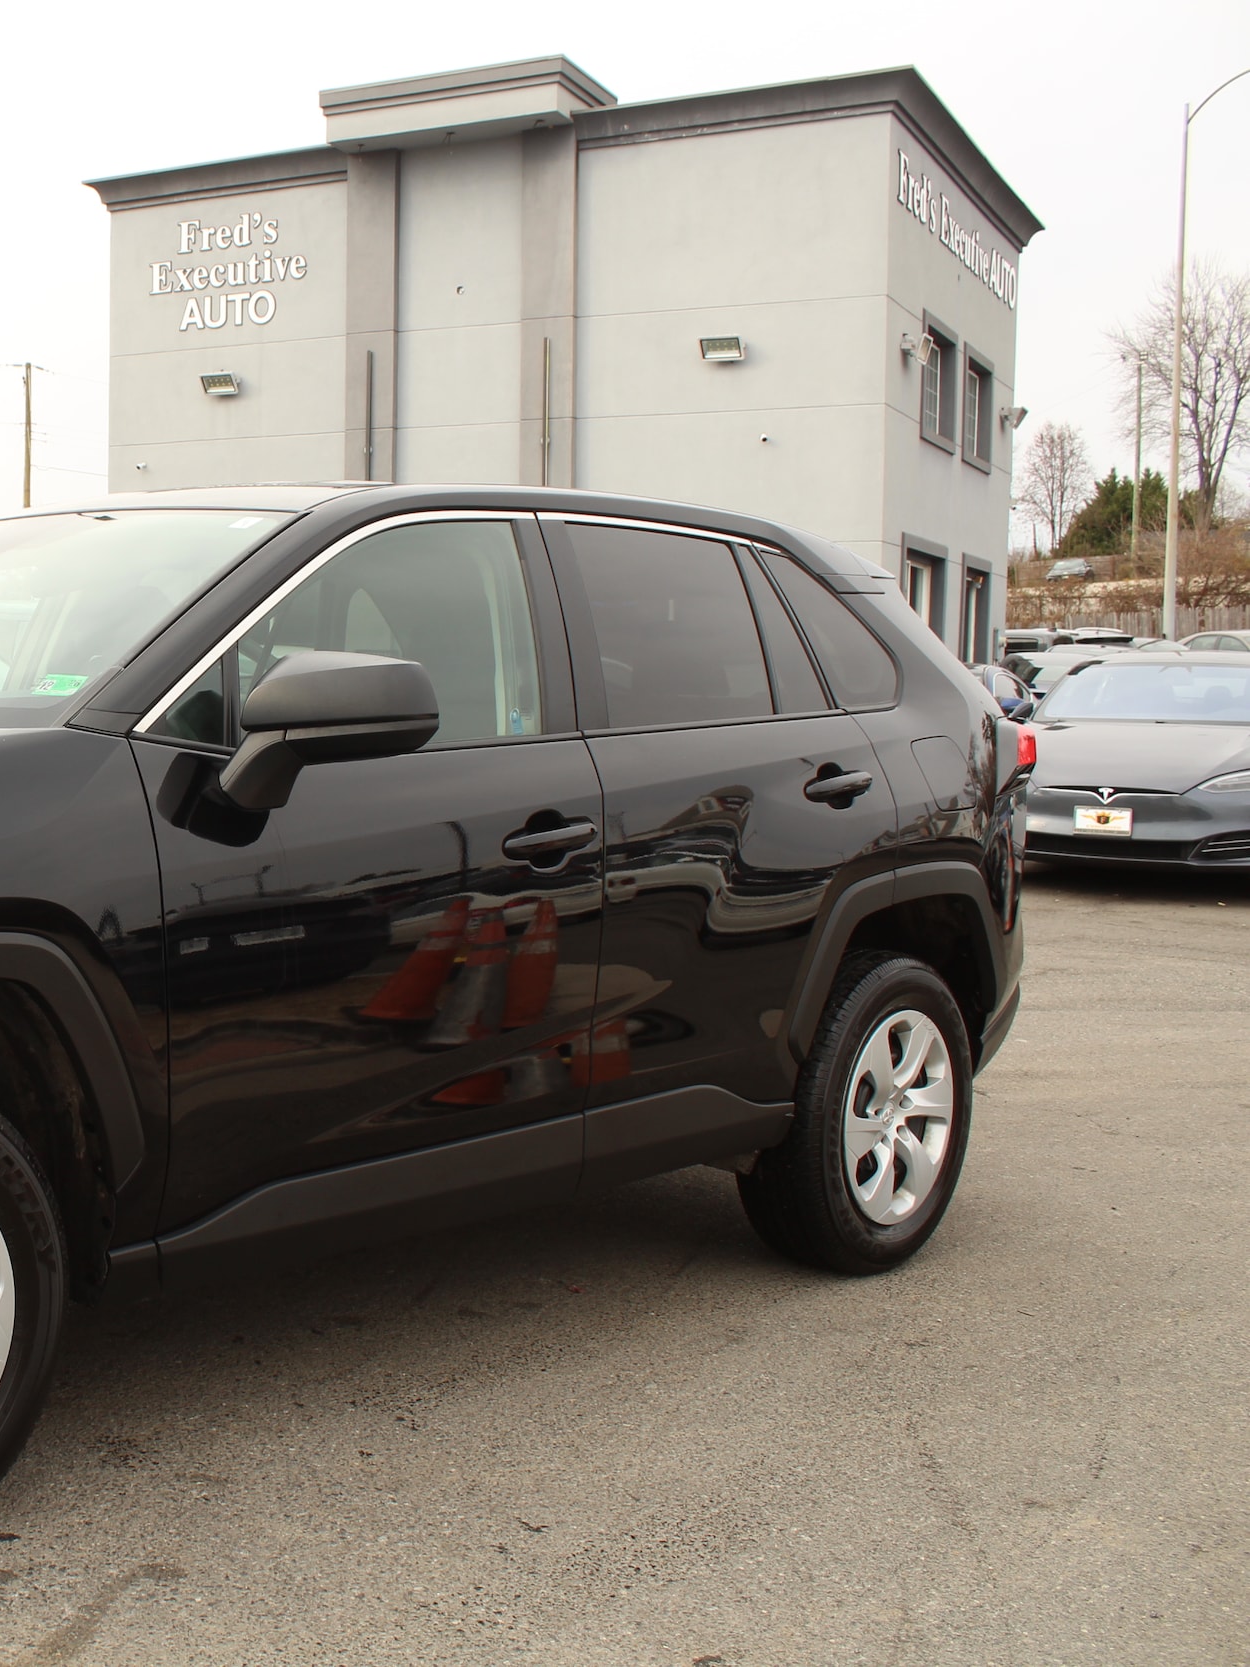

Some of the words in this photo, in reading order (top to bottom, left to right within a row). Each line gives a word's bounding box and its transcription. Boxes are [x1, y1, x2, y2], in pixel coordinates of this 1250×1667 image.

[177, 212, 279, 254] Fred's
[897, 148, 937, 234] Fred's
[939, 192, 990, 284] Executive
[988, 248, 1018, 311] AUTO
[149, 249, 307, 295] Executive
[179, 290, 277, 332] AUTO
